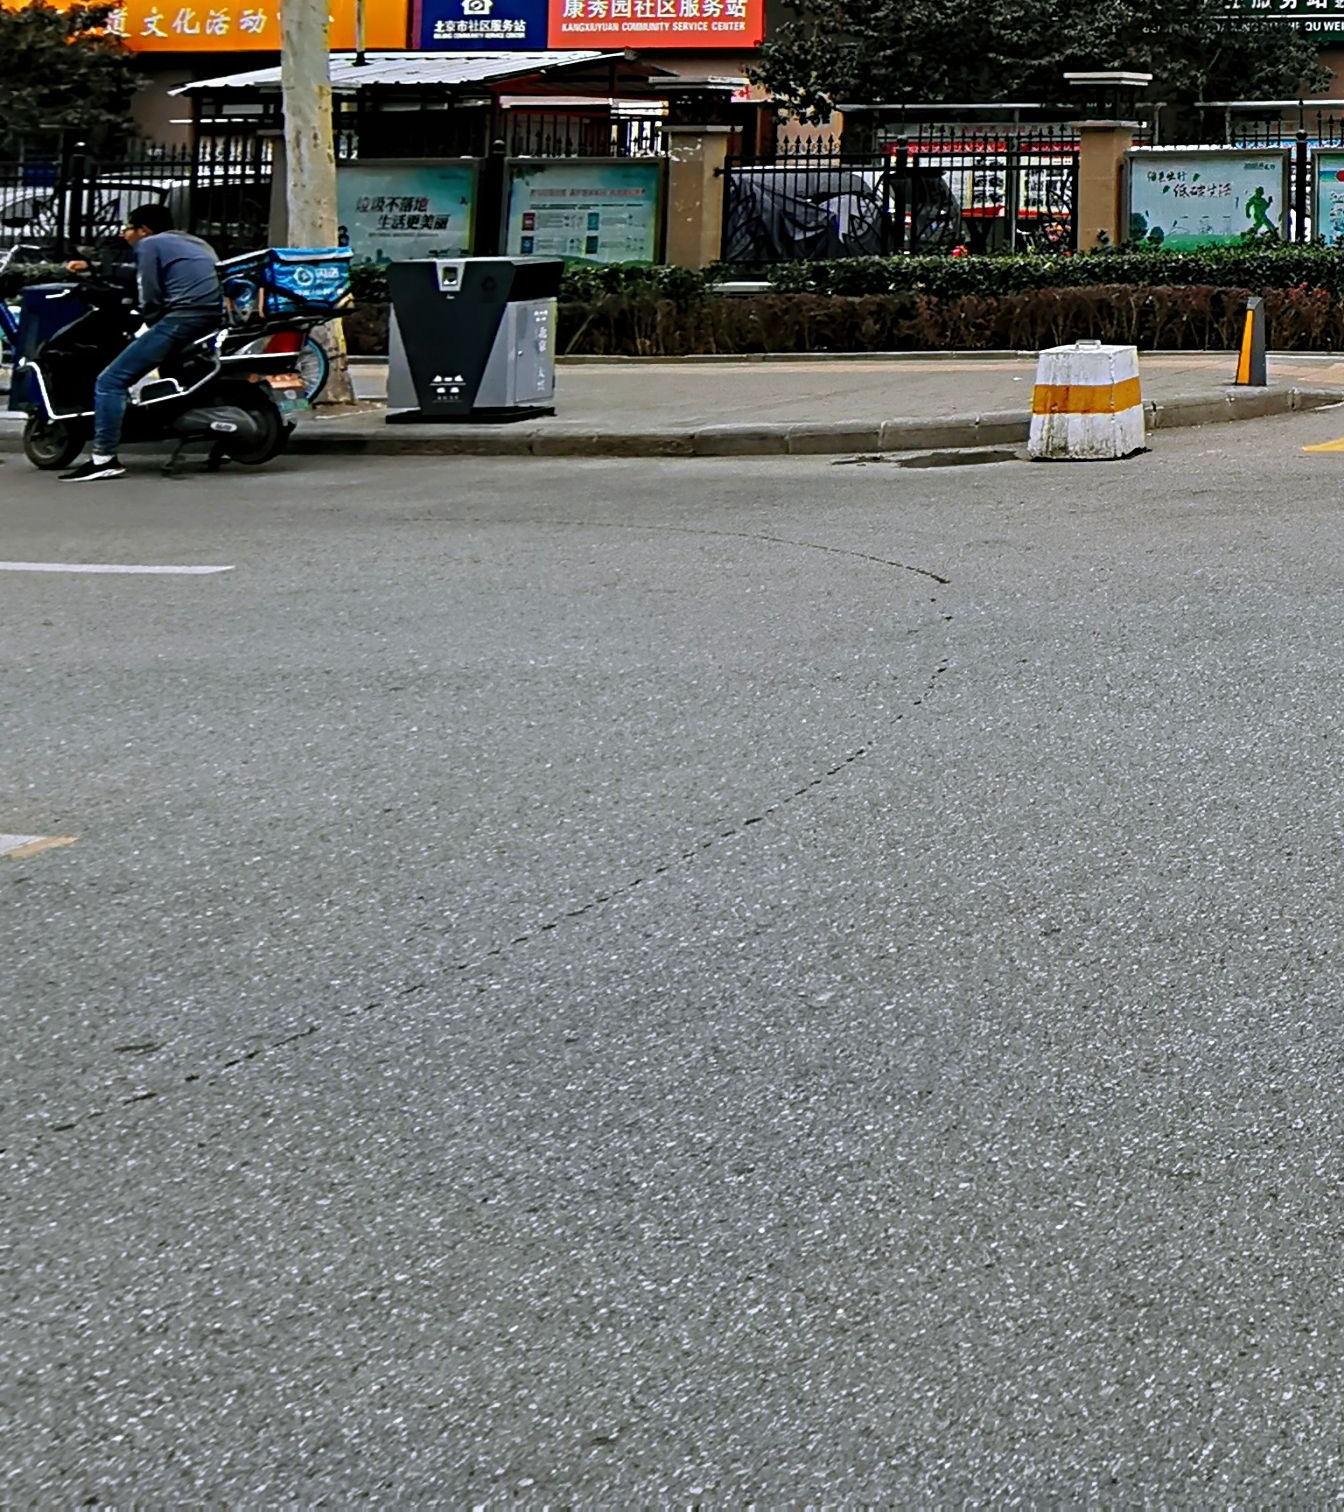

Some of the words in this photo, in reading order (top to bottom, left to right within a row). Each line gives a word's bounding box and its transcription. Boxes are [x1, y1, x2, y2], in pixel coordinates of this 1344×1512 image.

[103, 7, 335, 38] 道文化活动
[433, 19, 527, 32] 北京市社区服务站
[621, 21, 670, 32] COMMUNITY
[672, 21, 708, 31] SERVICE
[711, 20, 746, 31] CENTER
[1305, 21, 1321, 32] QU
[1323, 21, 1344, 31] WEI
[356, 196, 429, 213] 垃圾不落地
[378, 213, 450, 230] 生活更美丽
